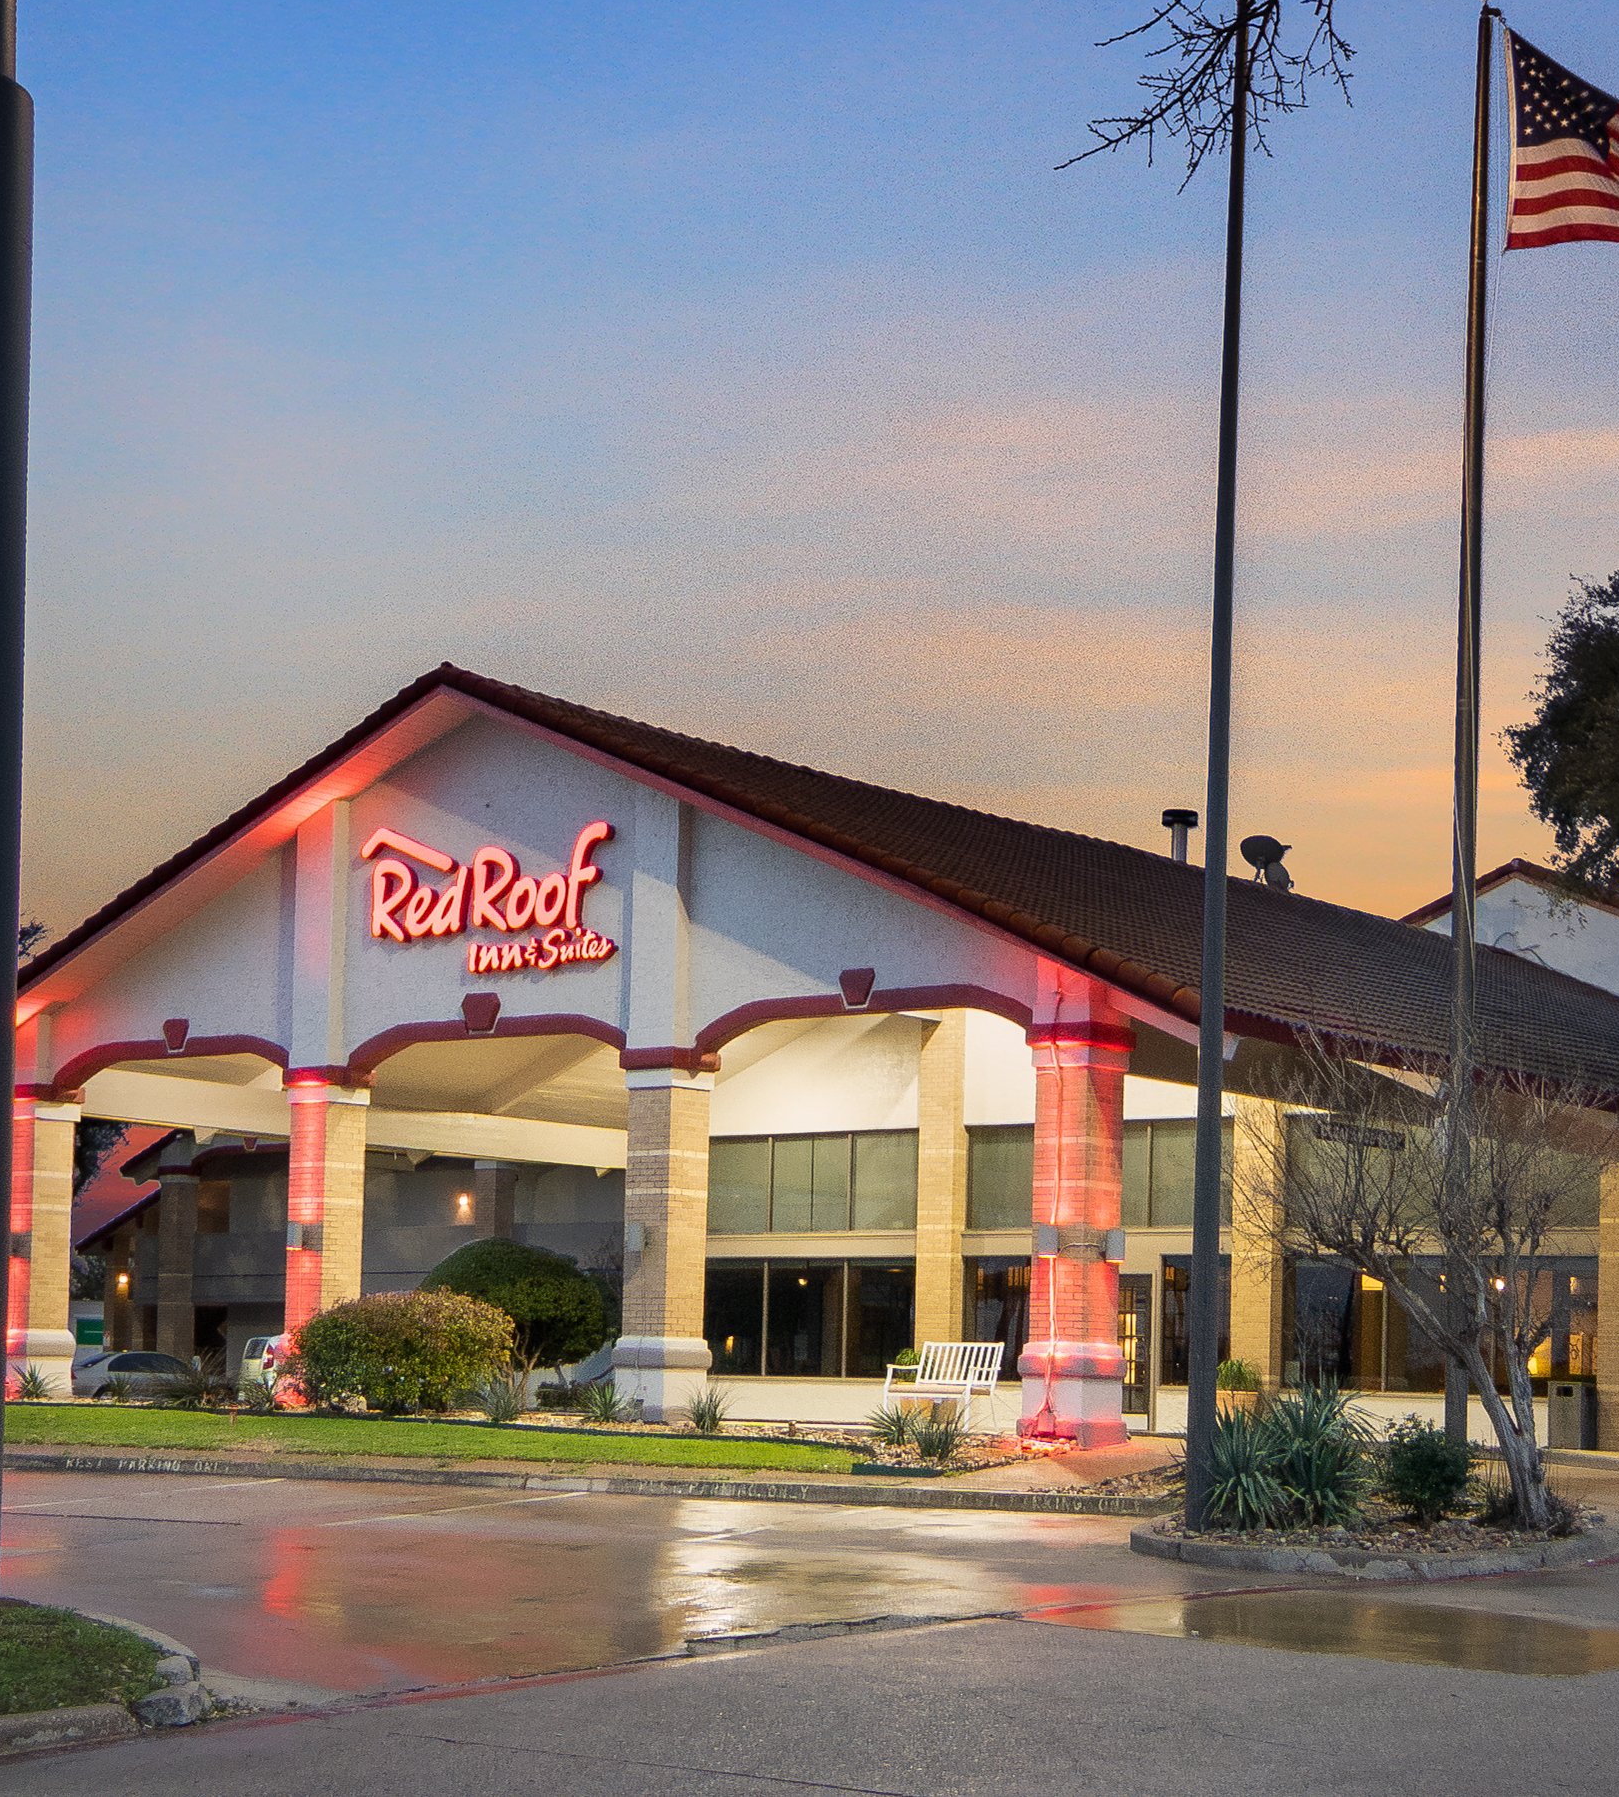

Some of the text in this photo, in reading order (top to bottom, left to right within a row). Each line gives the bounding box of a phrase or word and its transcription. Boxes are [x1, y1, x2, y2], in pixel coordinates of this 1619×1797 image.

[370, 820, 615, 943] Red Roof
[468, 927, 617, 973] Inn & Suites
[117, 1458, 181, 1473] PARKING
